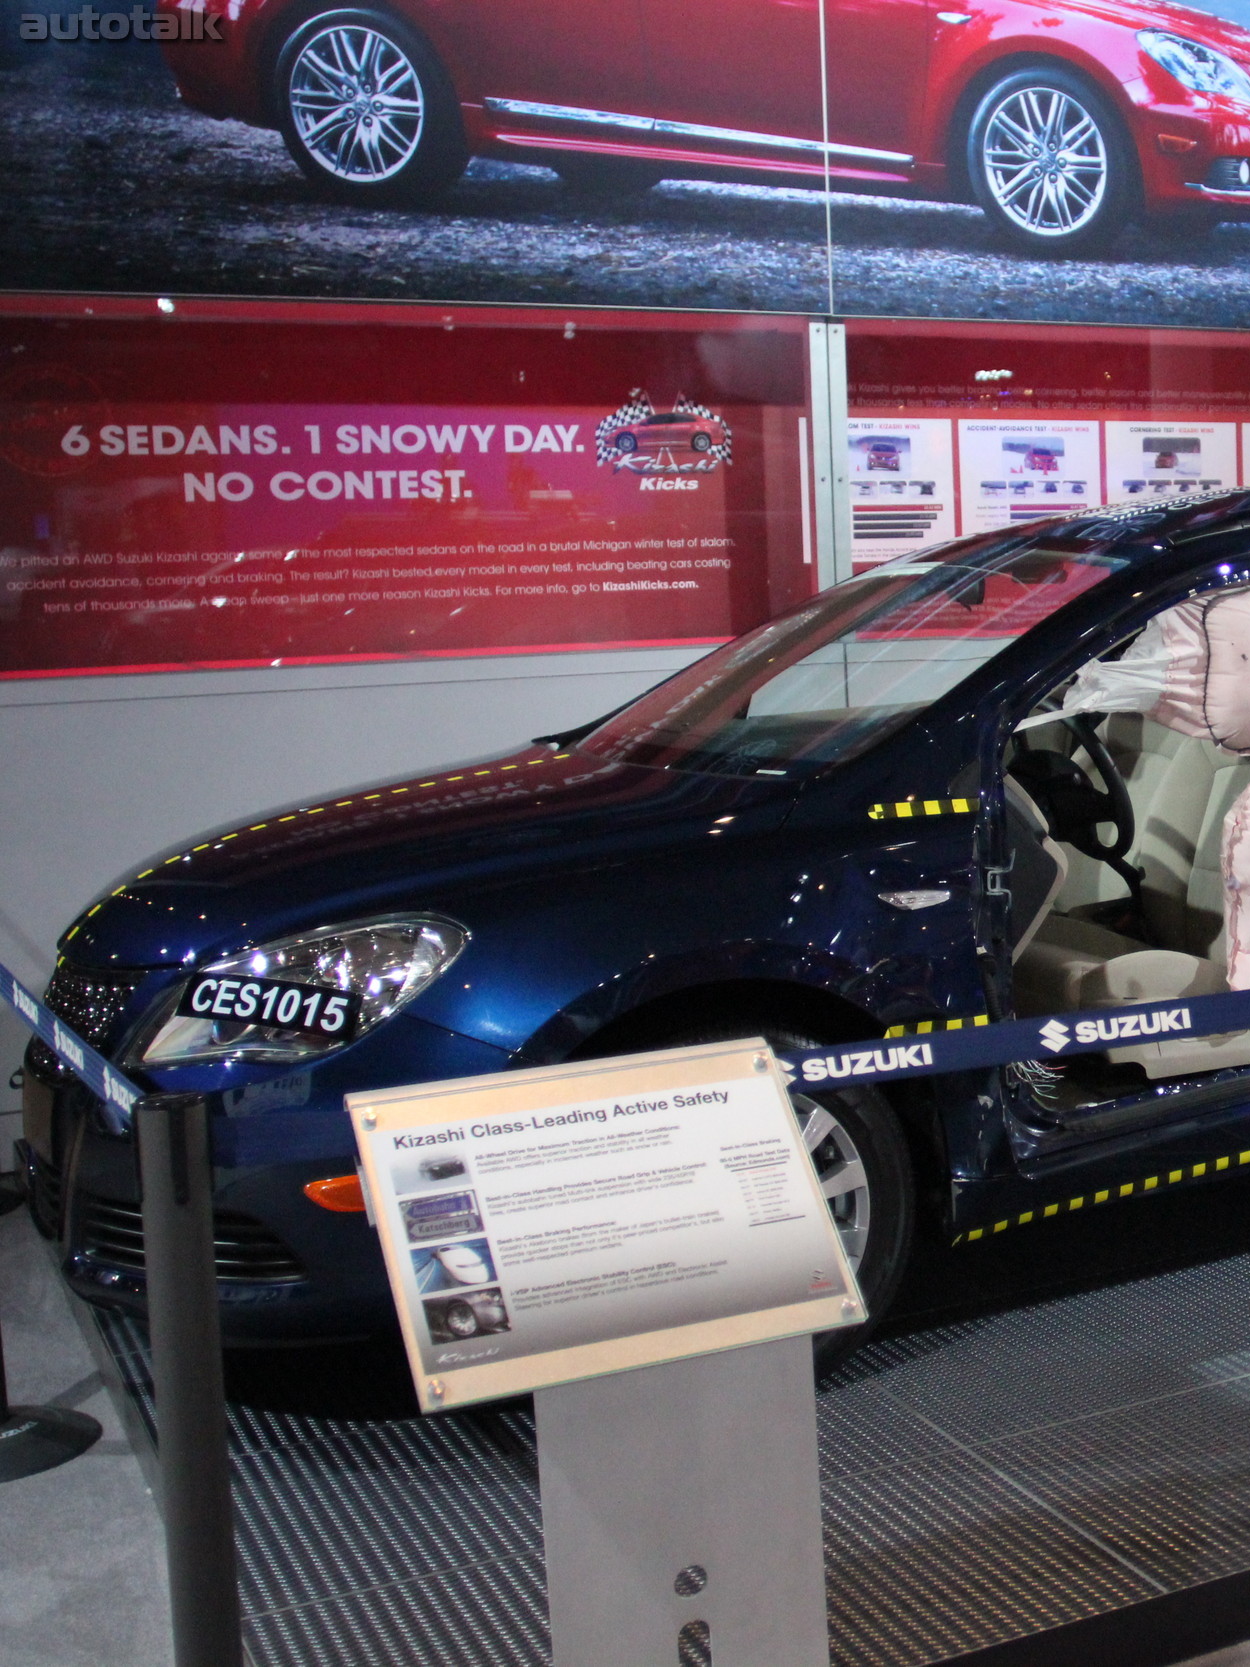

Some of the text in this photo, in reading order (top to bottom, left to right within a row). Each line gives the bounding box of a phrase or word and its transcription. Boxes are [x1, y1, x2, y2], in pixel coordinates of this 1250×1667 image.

[60, 424, 584, 456] 6 SEDANS. 1 SNOWY DAY.
[183, 469, 472, 502] NO CONTEST.
[639, 477, 698, 491] Kicks
[62, 556, 80, 565] an
[83, 553, 113, 564] AWD
[116, 551, 152, 563] Suzuki
[156, 550, 198, 562] Kizashi
[200, 549, 244, 564] again
[249, 551, 282, 560] some
[301, 547, 320, 558] the
[324, 546, 351, 557] most
[355, 544, 414, 559] respected
[416, 544, 456, 555] sedans
[460, 546, 474, 554] on
[477, 542, 495, 553] the
[498, 541, 524, 553] road
[526, 541, 536, 552] in
[538, 544, 548, 552] a
[549, 540, 580, 551] brutal
[582, 539, 632, 553] Michigan
[634, 538, 664, 549] winter
[666, 537, 684, 548] test
[686, 536, 698, 548] of
[6, 578, 66, 591] accident
[146, 574, 206, 587] cornering
[210, 572, 234, 584] and
[290, 570, 310, 581] The
[314, 568, 349, 580] result?
[352, 567, 390, 579] Kizashi
[434, 568, 466, 579] every
[468, 563, 504, 575] model
[507, 563, 517, 574] in
[520, 565, 550, 576] every
[576, 560, 624, 574] including
[626, 558, 668, 572] beating
[670, 560, 692, 569] cars
[694, 556, 731, 570] costing
[44, 600, 70, 611] tens
[74, 599, 86, 610] of
[90, 597, 156, 610] thousands
[200, 595, 209, 606] A
[322, 593, 345, 601] one
[348, 591, 380, 600] more
[383, 590, 421, 599] reason
[424, 585, 460, 597] Kizashi
[495, 584, 512, 595] For
[515, 585, 544, 594] more
[572, 584, 587, 595] go
[589, 580, 600, 591] to
[602, 578, 699, 591] KizashiKicks.com.
[191, 978, 349, 1032] CES1015
[1075, 1007, 1192, 1045] SUZUKI
[801, 1043, 933, 1083] SUZUKI
[393, 1090, 729, 1150] Kizashi Class-Leading Active Safety
